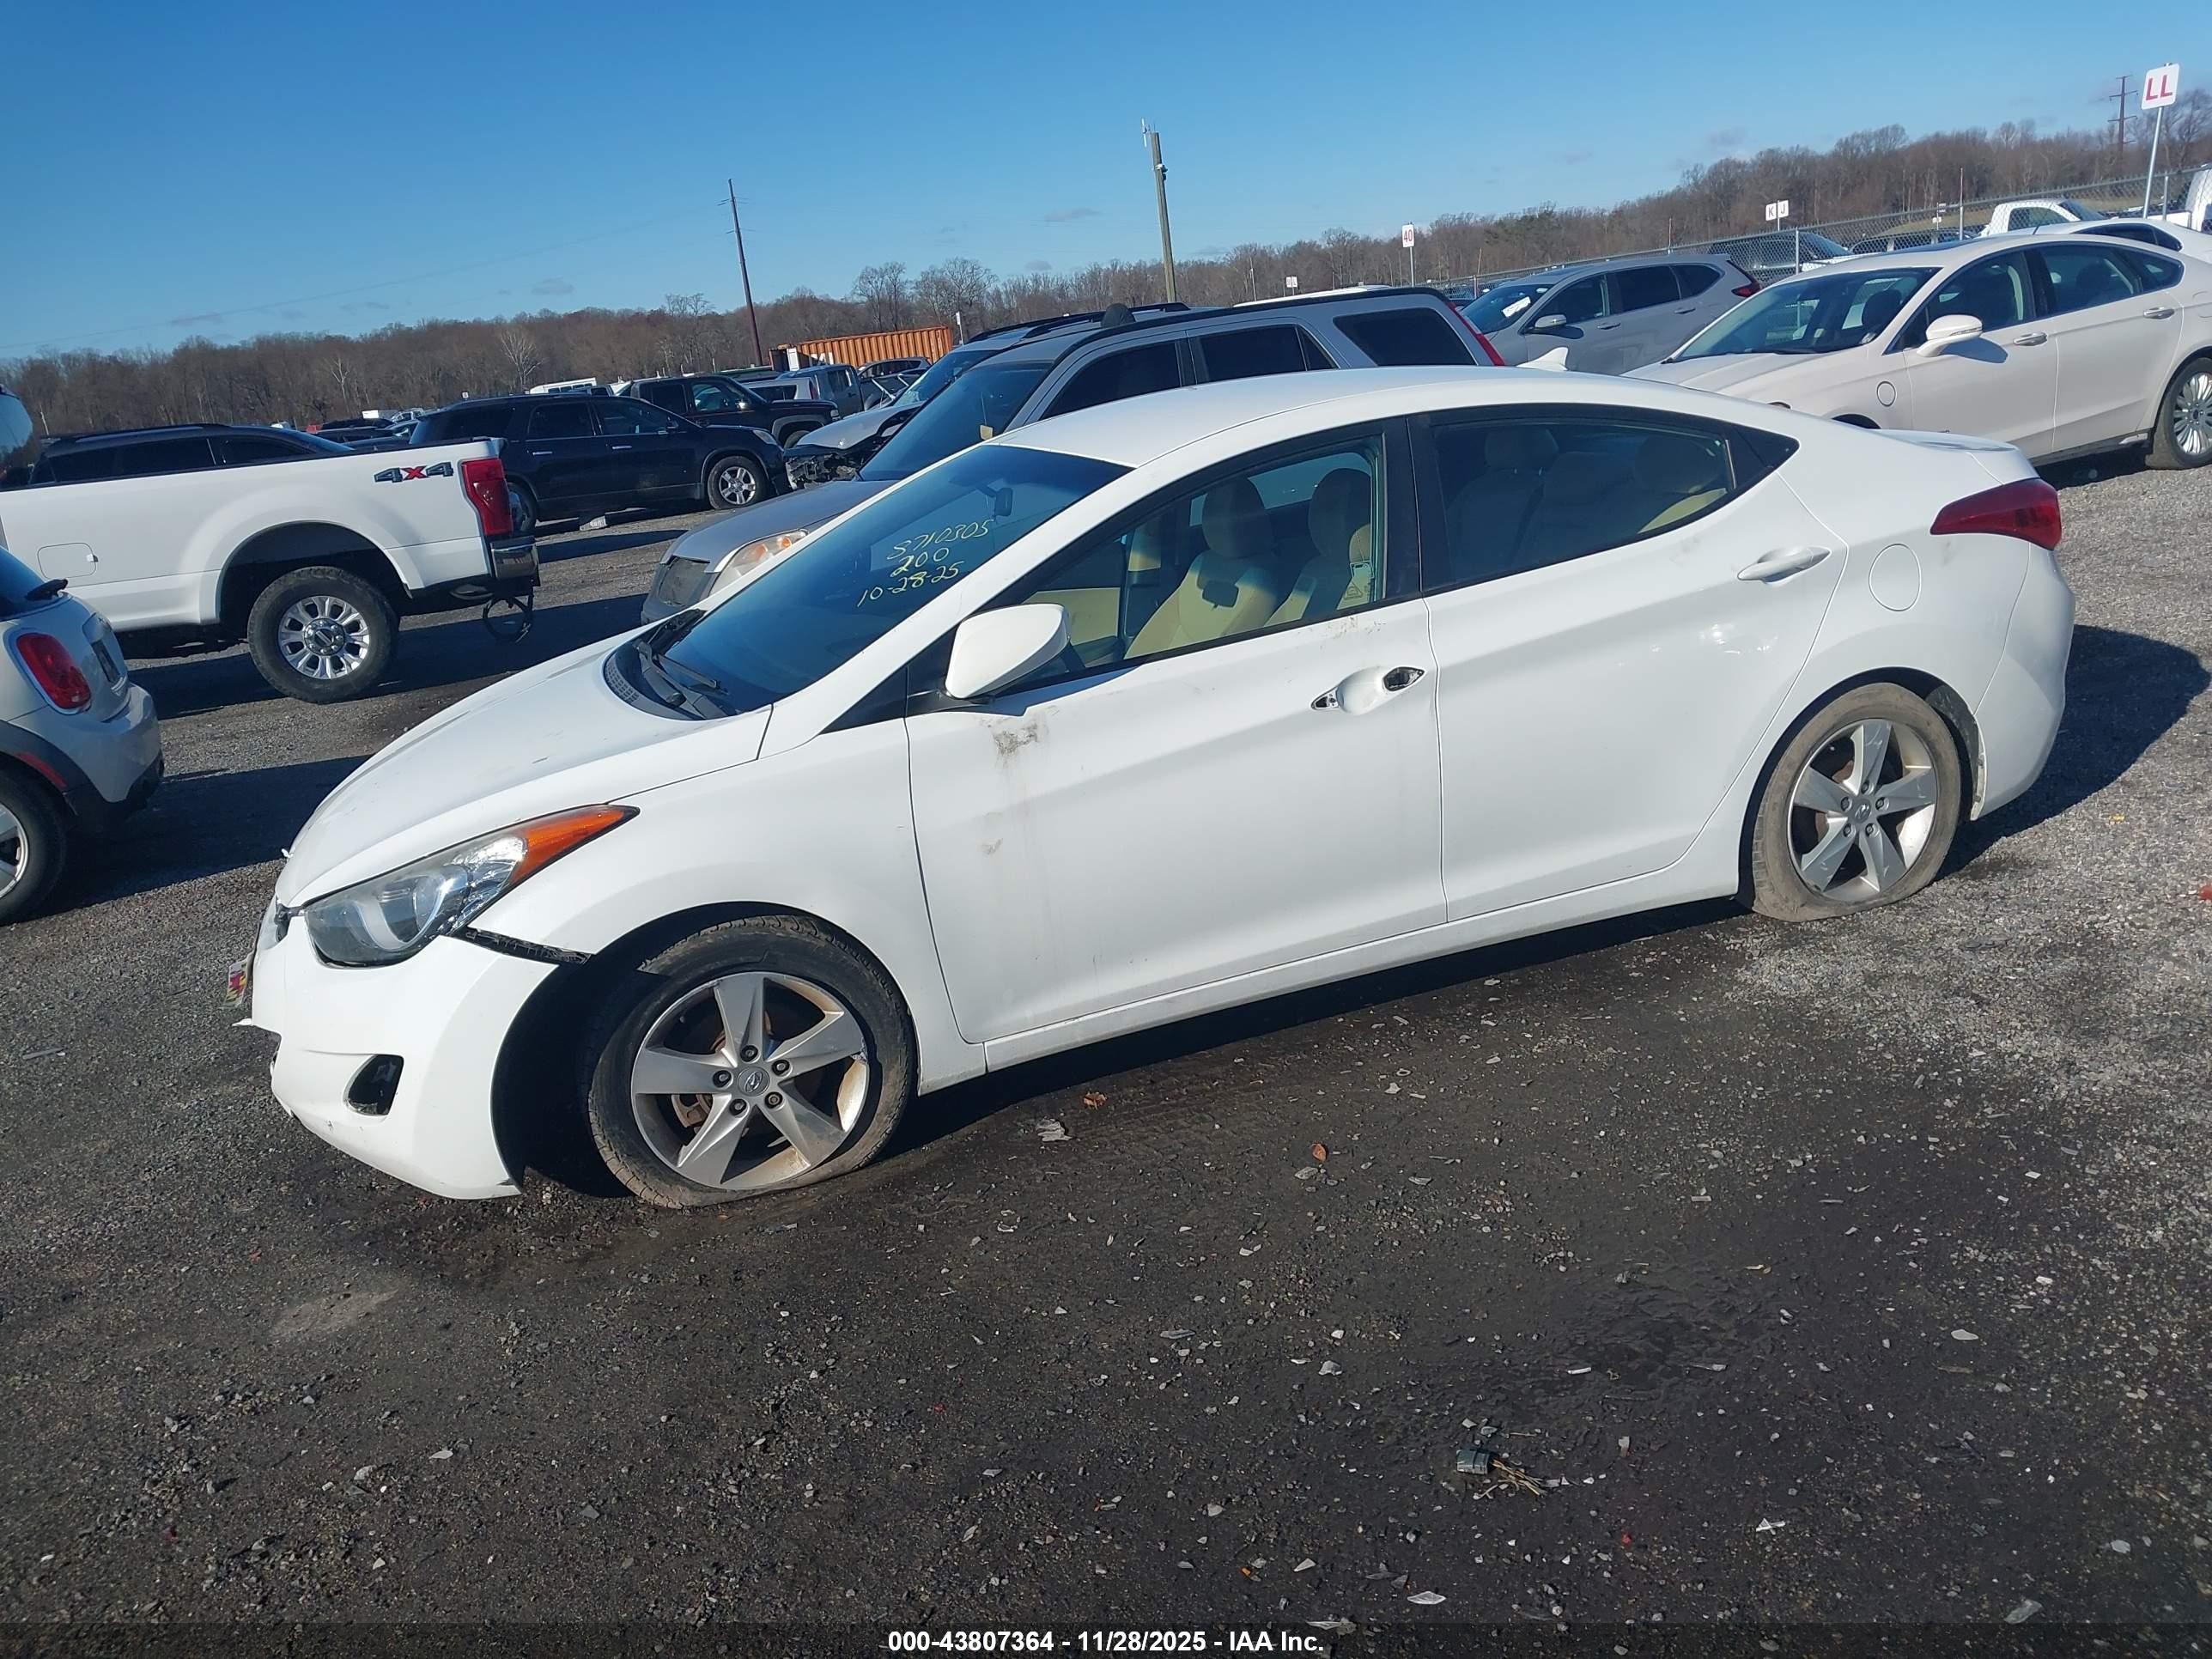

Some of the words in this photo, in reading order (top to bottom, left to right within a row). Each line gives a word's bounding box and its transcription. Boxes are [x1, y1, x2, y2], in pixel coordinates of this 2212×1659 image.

[2146, 75, 2172, 100] LL
[1403, 229, 1413, 242] 40
[890, 547, 950, 577] 200
[857, 561, 964, 607] 10-28-25
